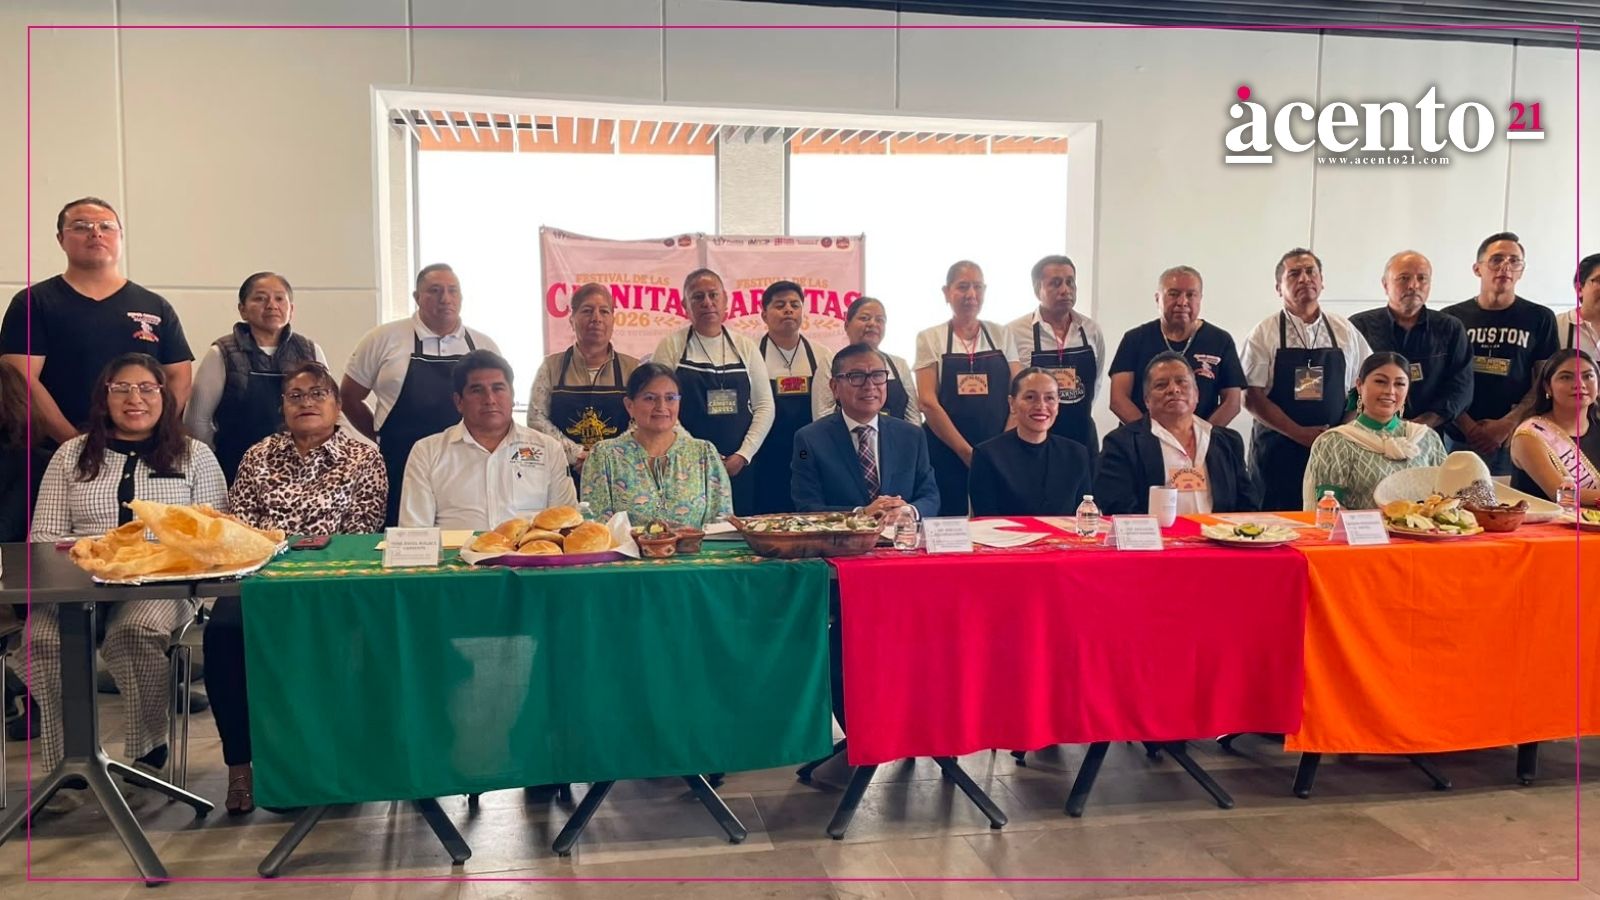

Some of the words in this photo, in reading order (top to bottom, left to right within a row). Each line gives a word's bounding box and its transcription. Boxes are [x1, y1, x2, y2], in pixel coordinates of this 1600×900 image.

[575, 273, 630, 284] FESTIVAL
[633, 274, 648, 284] DE
[651, 276, 671, 285] LAS
[808, 278, 829, 288] LAS
[546, 282, 690, 320] CNITA
[613, 312, 650, 327] 026
[1466, 327, 1530, 348] OUSTON
